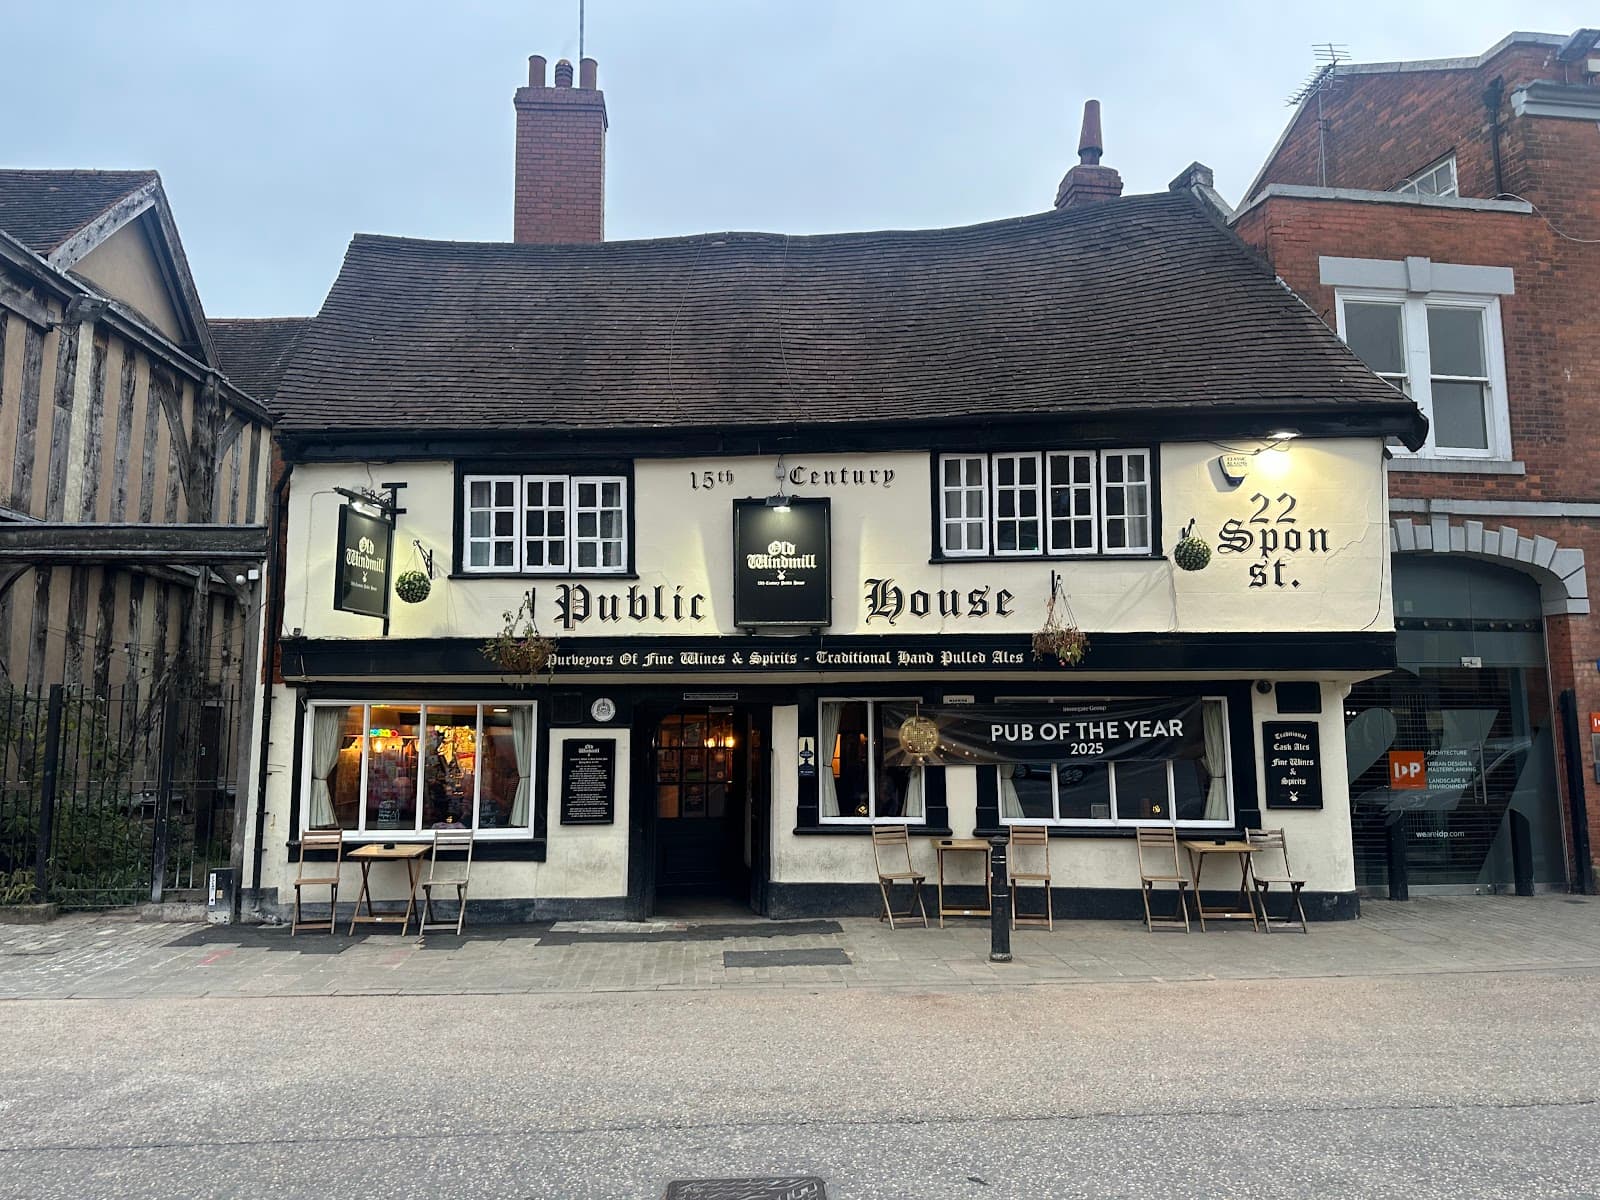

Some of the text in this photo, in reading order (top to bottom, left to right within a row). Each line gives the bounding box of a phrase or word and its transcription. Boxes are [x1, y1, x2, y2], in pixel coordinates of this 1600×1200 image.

[690, 466, 896, 490] 15th Century
[1249, 492, 1297, 524] 22
[359, 536, 375, 555] Old
[767, 540, 797, 556] Old
[1217, 518, 1331, 560] Spon
[346, 548, 384, 573] Windmill
[746, 553, 818, 570] Windmill
[553, 578, 1016, 632] Public House
[545, 653, 614, 668] Purveyors
[619, 652, 639, 666] Of
[642, 652, 674, 667] Fine
[680, 651, 726, 665] Wines
[731, 652, 744, 665] &
[748, 652, 798, 667] Spirits
[816, 650, 892, 664] Traditional
[897, 650, 934, 666] Hand
[940, 650, 986, 666] Pulled
[991, 650, 1024, 664] Ales
[991, 719, 1184, 742] PUB OF THE YEAR
[1070, 742, 1104, 755] 2025
[1293, 743, 1310, 751] Ales
[1271, 758, 1315, 767] Fine Wines
[1289, 767, 1297, 776] &
[1280, 777, 1307, 786] Spirits
